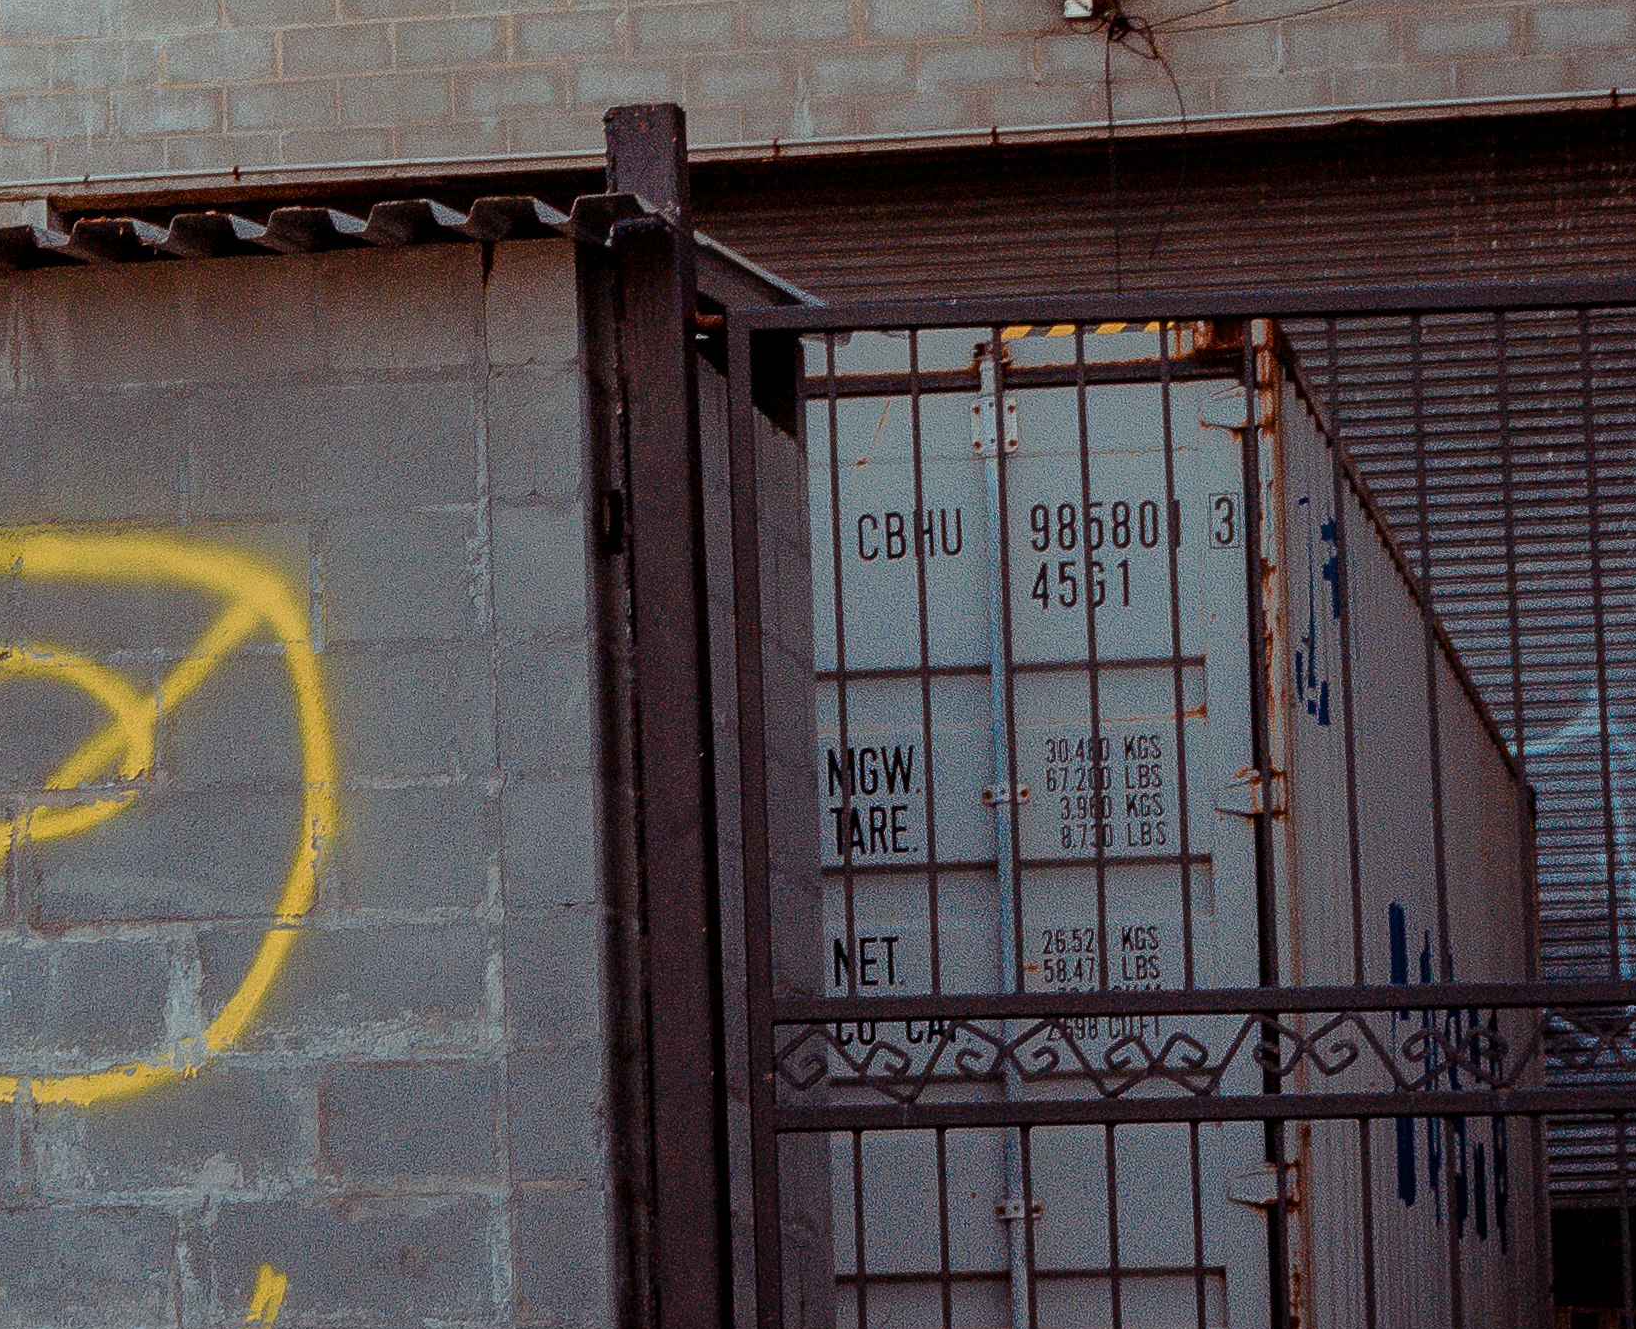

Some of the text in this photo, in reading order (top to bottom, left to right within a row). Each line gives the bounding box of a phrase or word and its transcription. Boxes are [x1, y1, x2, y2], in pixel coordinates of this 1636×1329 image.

[856, 507, 964, 563] CBHU
[1213, 495, 1237, 546] 3
[1030, 559, 1132, 611] 45G1
[1124, 735, 1163, 761] KGS
[1125, 764, 1164, 790] LBS
[1126, 792, 1166, 818] KGS
[1127, 821, 1168, 848] LBS
[1042, 925, 1160, 955] 26.52 KGS
[1043, 956, 1161, 984] 58.47 LBS
